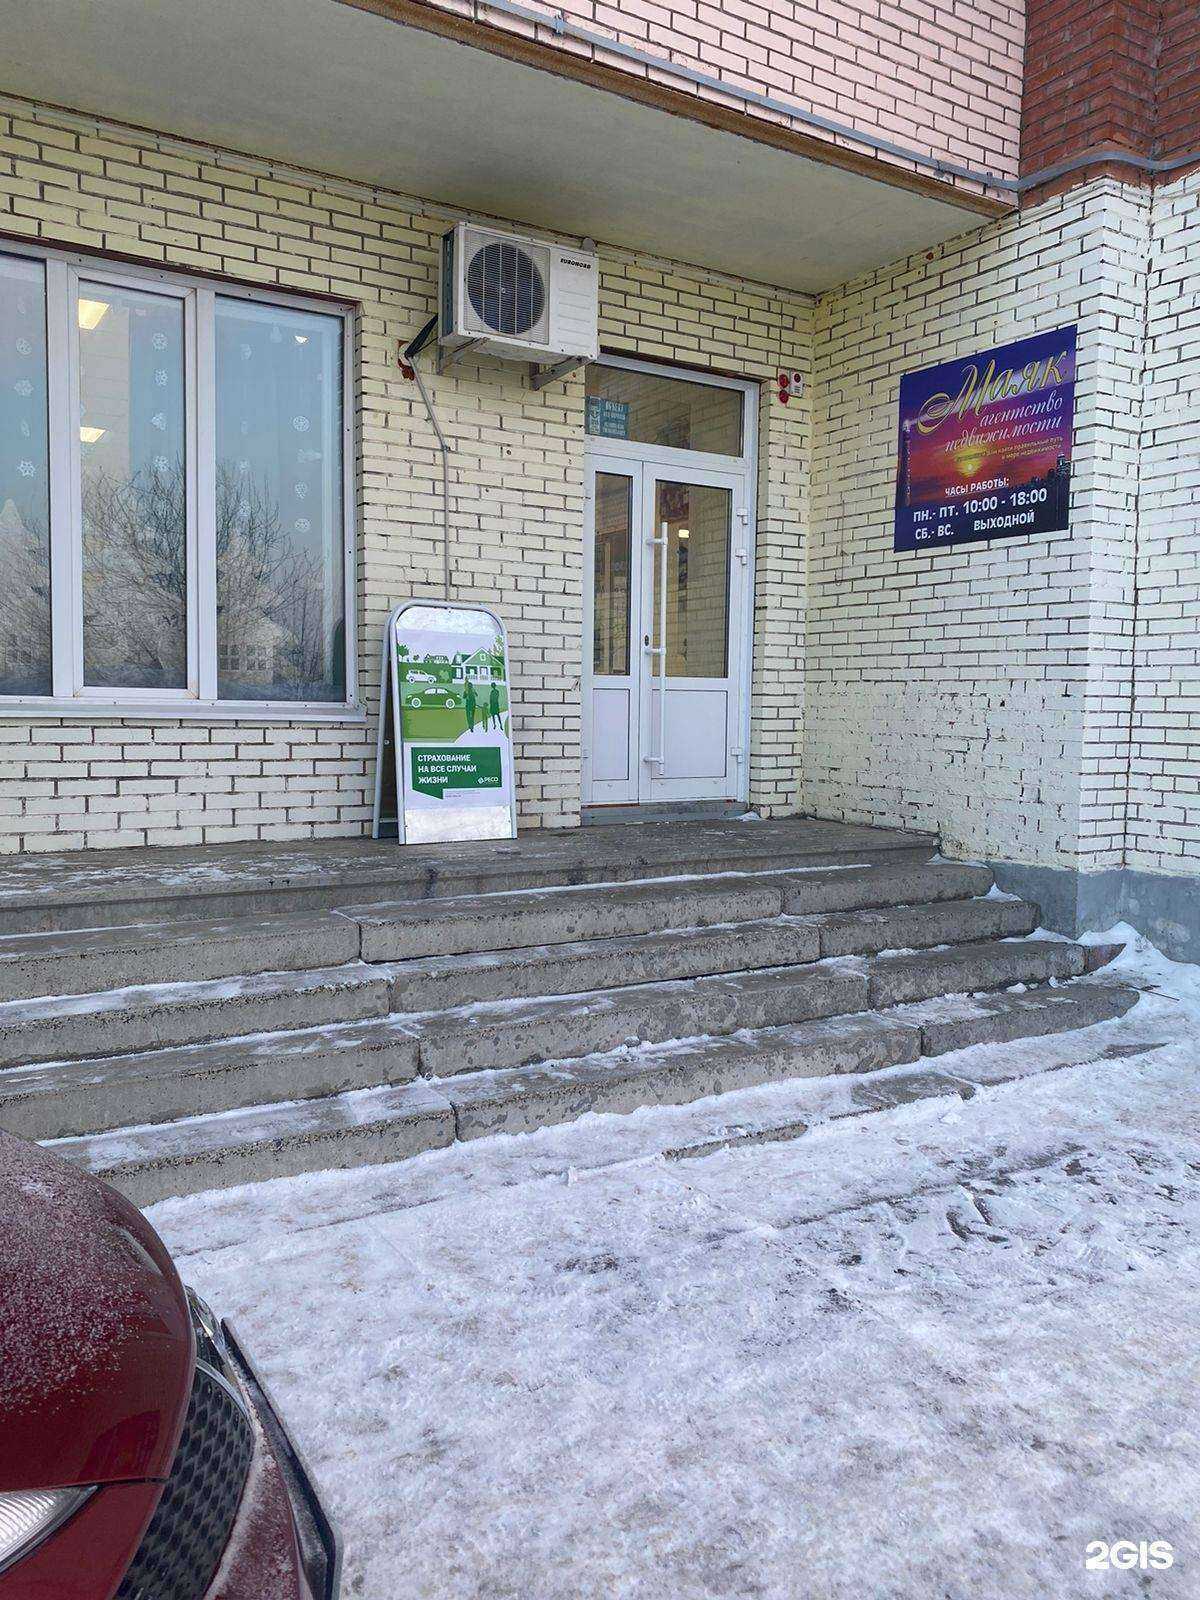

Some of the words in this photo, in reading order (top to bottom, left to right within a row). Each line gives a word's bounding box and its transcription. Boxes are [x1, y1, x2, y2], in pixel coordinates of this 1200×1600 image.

[916, 350, 1068, 435] Маяк
[980, 389, 1063, 428] агентство
[945, 416, 1062, 452] недвижимости
[945, 485, 969, 496] ЧАСЫ
[970, 477, 1009, 492] РАБОТЫ:
[939, 505, 959, 518] ПТ.
[963, 496, 998, 514] 10:00
[1009, 487, 1048, 507] 18:00
[937, 523, 955, 537] ВС.
[974, 509, 1035, 531] ВЫХОДНОЙ
[417, 754, 472, 762] СТРАХОВАНИЕ
[418, 765, 430, 773] НА
[430, 765, 446, 773] ВСЕ
[418, 776, 449, 784] ЖИЗНИ
